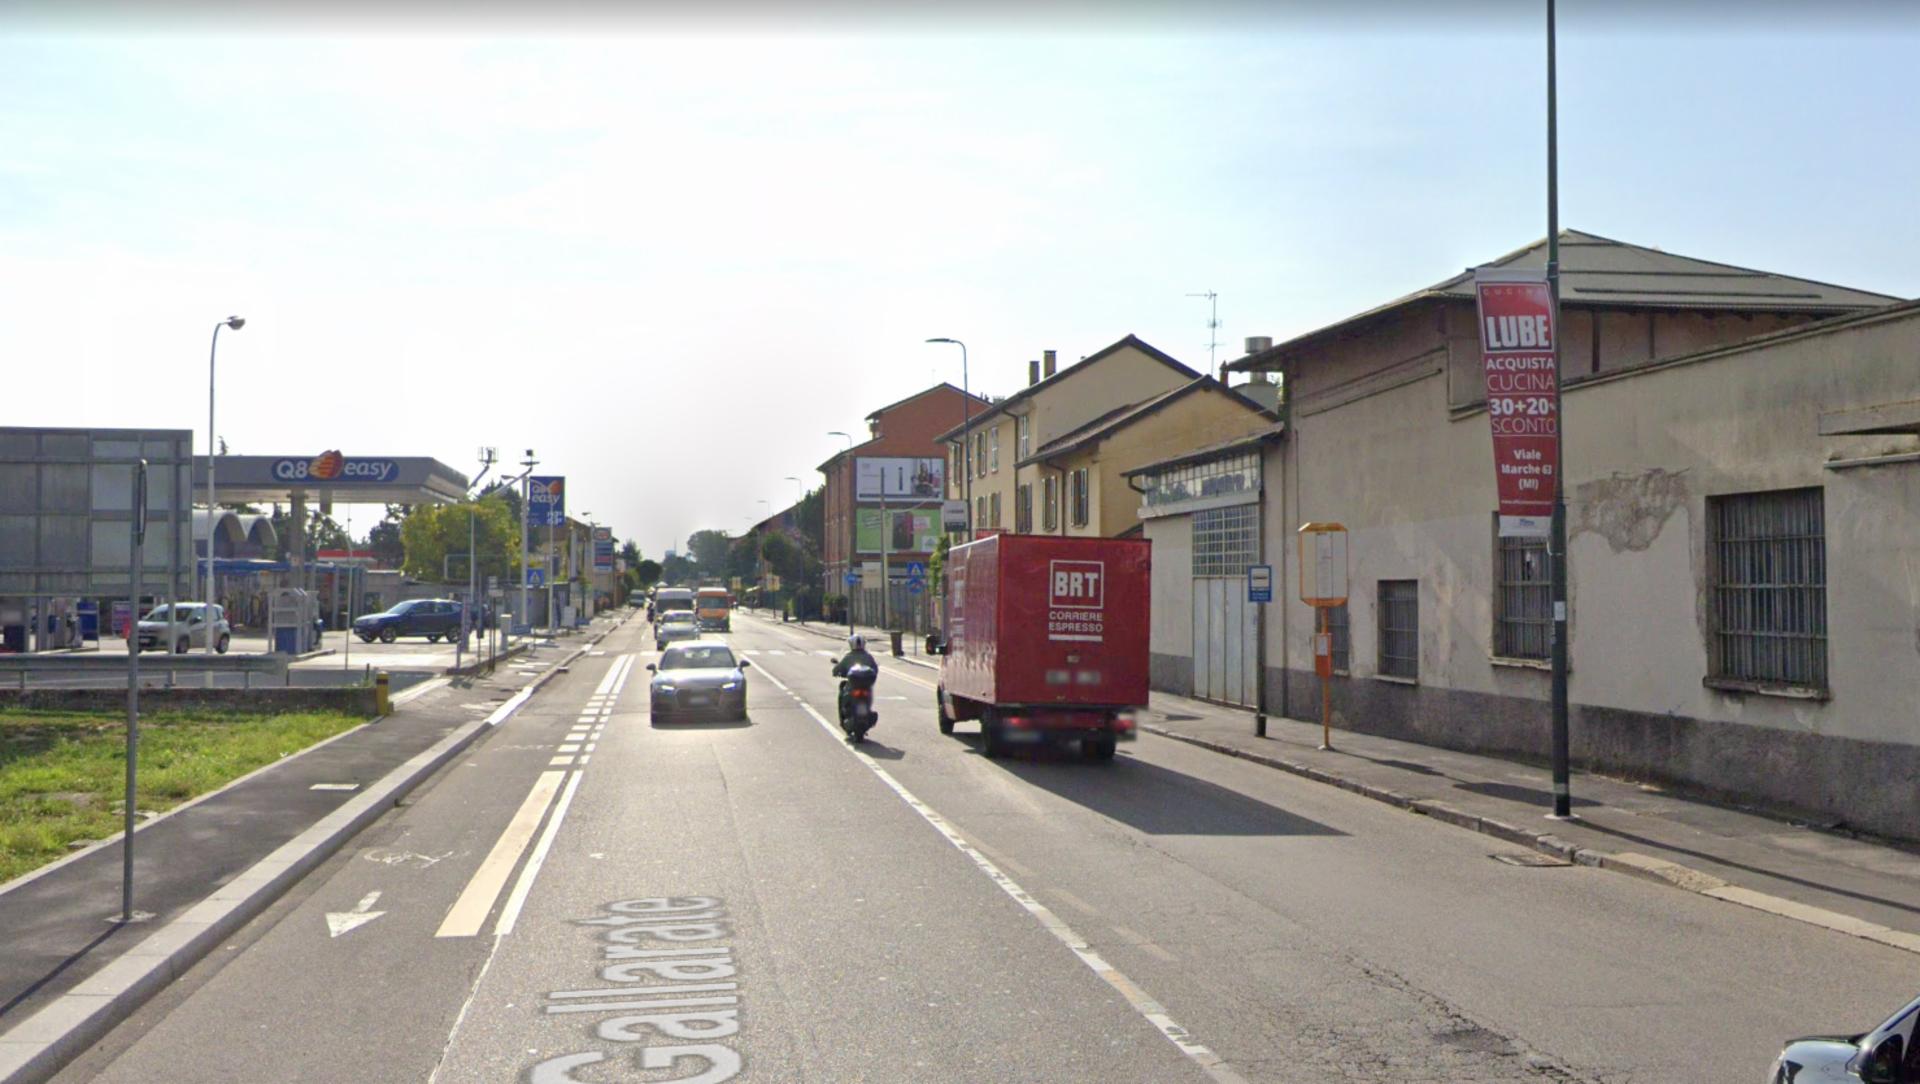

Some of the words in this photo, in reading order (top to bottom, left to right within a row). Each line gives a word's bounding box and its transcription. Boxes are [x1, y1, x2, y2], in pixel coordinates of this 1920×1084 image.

[1486, 315, 1550, 348] LUBE
[1487, 357, 1554, 371] ACQUISTA
[1488, 373, 1554, 392] CUCINA
[1492, 417, 1557, 433] SCONTO
[1513, 449, 1541, 460] Viale
[276, 460, 308, 479] Q8
[344, 462, 392, 481] easy
[1501, 464, 1540, 475] Marche
[1518, 478, 1540, 490] (MI)
[531, 493, 561, 506] easy
[1054, 571, 1099, 597] BRT
[1048, 610, 1104, 622] CORRIERE
[1048, 622, 1104, 632] ESPRESSO
